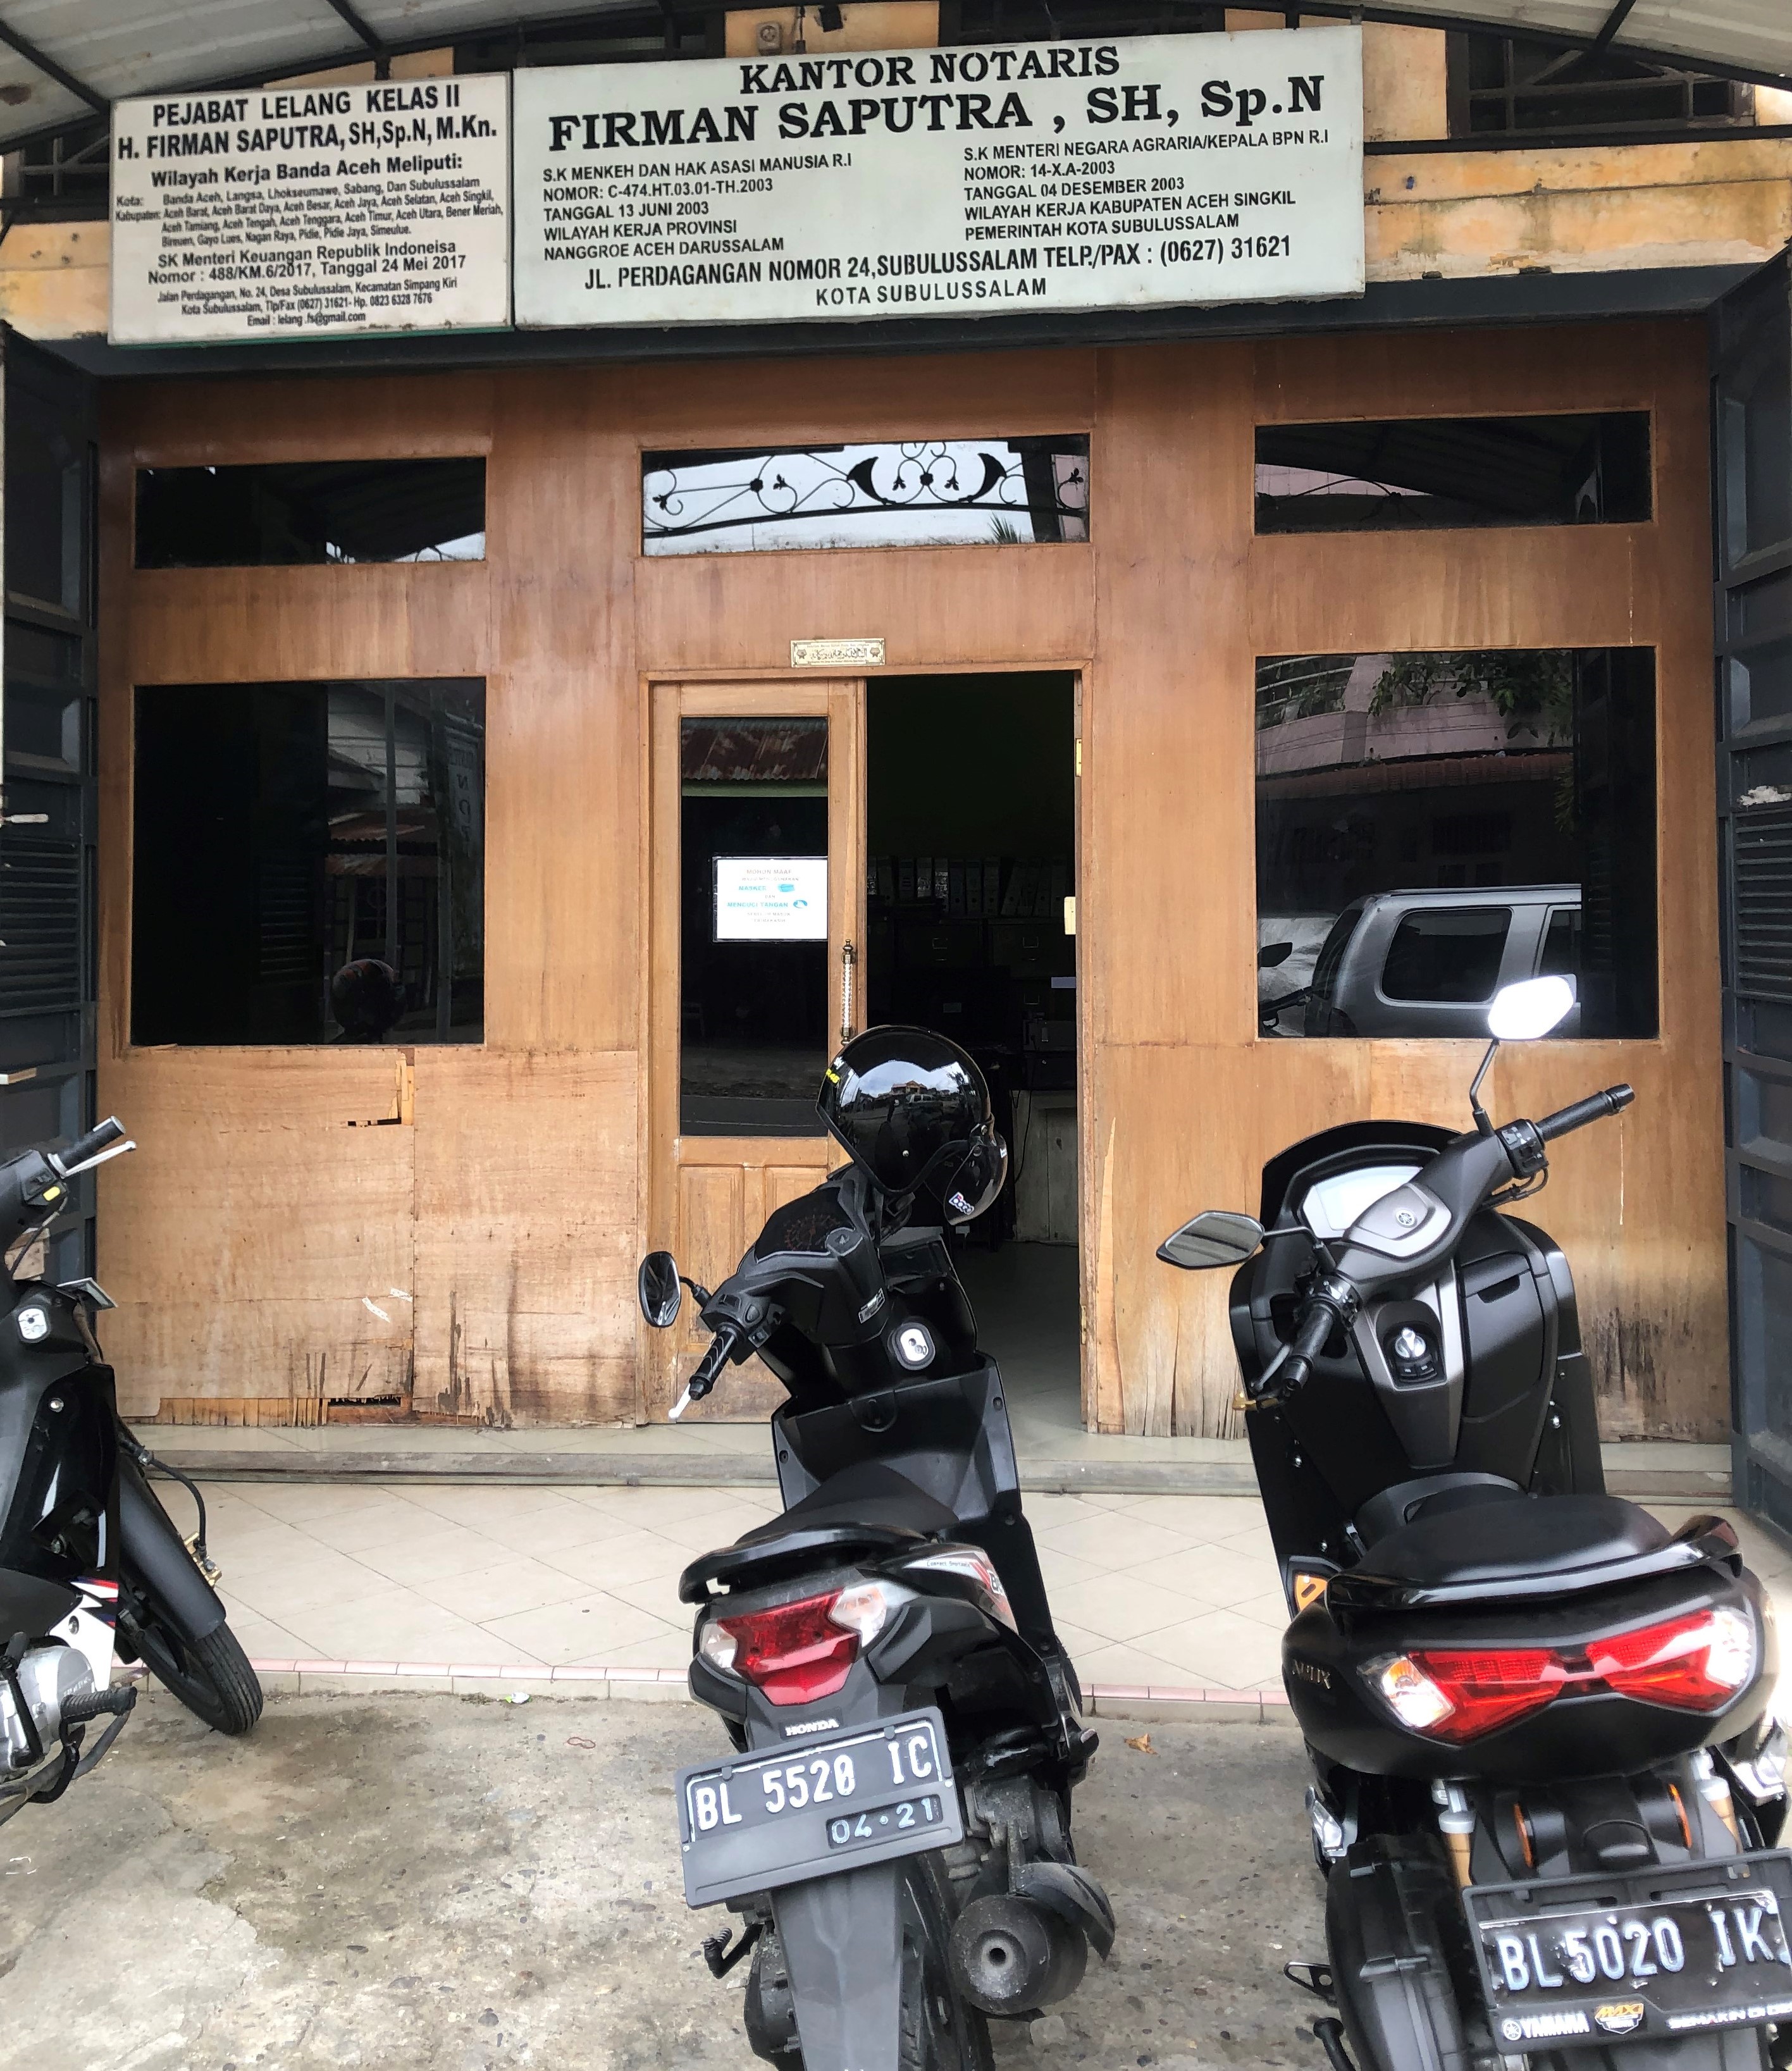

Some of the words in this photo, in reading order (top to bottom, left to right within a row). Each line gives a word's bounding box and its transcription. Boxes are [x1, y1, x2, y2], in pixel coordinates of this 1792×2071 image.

[739, 56, 917, 95] KANTOR
[929, 45, 1120, 83] NOTARIS
[152, 97, 249, 127] PEJABAT
[261, 90, 351, 120] LELANG
[366, 85, 438, 113] KELAS
[445, 83, 460, 108] II
[548, 105, 759, 152] FIRMAN
[777, 91, 1033, 139] SAPUTRA
[1086, 83, 1179, 128] SH,
[1201, 75, 1325, 127] Sp.N
[118, 136, 140, 160] H.
[147, 130, 229, 159] FIRMAN
[236, 123, 345, 152] SAPUTRA,
[436, 114, 497, 140] M.Kn.
[963, 146, 989, 161] S.K
[992, 142, 1060, 159] MENTERI
[1064, 139, 1129, 156] NEGARA
[1132, 132, 1269, 152] AGRARIA/KEPALA
[1272, 130, 1304, 146] BPN
[1309, 128, 1328, 144] R.I
[151, 167, 219, 190] Wilayah
[223, 164, 271, 186] Kerja
[276, 161, 331, 180] Banda
[335, 157, 381, 176] Aceh
[386, 152, 462, 176] Meliputi:
[543, 168, 567, 182] S.K
[571, 164, 634, 181] MENKEH
[638, 163, 670, 177] DAN
[675, 161, 707, 176] HAK
[709, 159, 755, 175] ASASI
[759, 154, 829, 172] MANUSIA
[832, 152, 851, 168] R.I
[964, 164, 1025, 182] NOMOR:
[1030, 160, 1115, 178] 14-X.A-2003
[543, 185, 603, 202] NOMOR:
[607, 177, 773, 199] C-474.HT.03.01-TH.2003
[963, 183, 1037, 201] TANGGAL
[1040, 183, 1058, 197] 04
[1061, 178, 1147, 196] DESEMBER
[1151, 176, 1185, 192] 2003
[543, 204, 614, 221] TANGGAL
[618, 203, 634, 218] 13
[638, 202, 672, 217] JUNI
[676, 201, 709, 216] 2003
[964, 204, 1031, 221] WILAYAH
[1035, 201, 1087, 218] KERJA
[1089, 195, 1182, 215] KABUPATEN
[1185, 193, 1228, 209] ACEH
[1233, 190, 1296, 206] SINGKIL
[543, 224, 609, 242] WILAYAH
[613, 222, 663, 238] KERJA
[666, 219, 737, 236] PROVINSI
[965, 222, 1062, 241] PEMERINTAH
[1066, 220, 1108, 236] KOTA
[1111, 213, 1239, 234] SUBULUSSALAM
[158, 253, 178, 269] SK
[182, 250, 235, 266] Menteri
[239, 249, 312, 264] Keuangan
[316, 242, 381, 262] Republik
[543, 243, 629, 261] NANGGROE
[633, 241, 674, 256] ACEH
[679, 237, 784, 255] DARUSSALAM
[584, 268, 611, 290] JL.
[618, 261, 762, 288] PERDAGANGAN
[769, 257, 841, 281] NOMOR
[1160, 238, 1224, 268] (0627)
[1230, 235, 1289, 259] 31621
[147, 269, 195, 285] Nomor
[319, 258, 377, 278] Tanggal
[381, 257, 399, 273] 24
[402, 256, 428, 272] Mei
[432, 254, 466, 270] 2017
[816, 286, 871, 306] KOTA
[877, 277, 1046, 303] SUBULUSSALAM
[786, 1718, 839, 1736] HONDA
[696, 1783, 743, 1831] BL
[762, 1754, 856, 1814] 5520
[887, 1735, 932, 1785] IC
[1497, 1934, 1563, 1991] BL
[1564, 1917, 1685, 1984] 5020
[1709, 1909, 1775, 1966] IK
